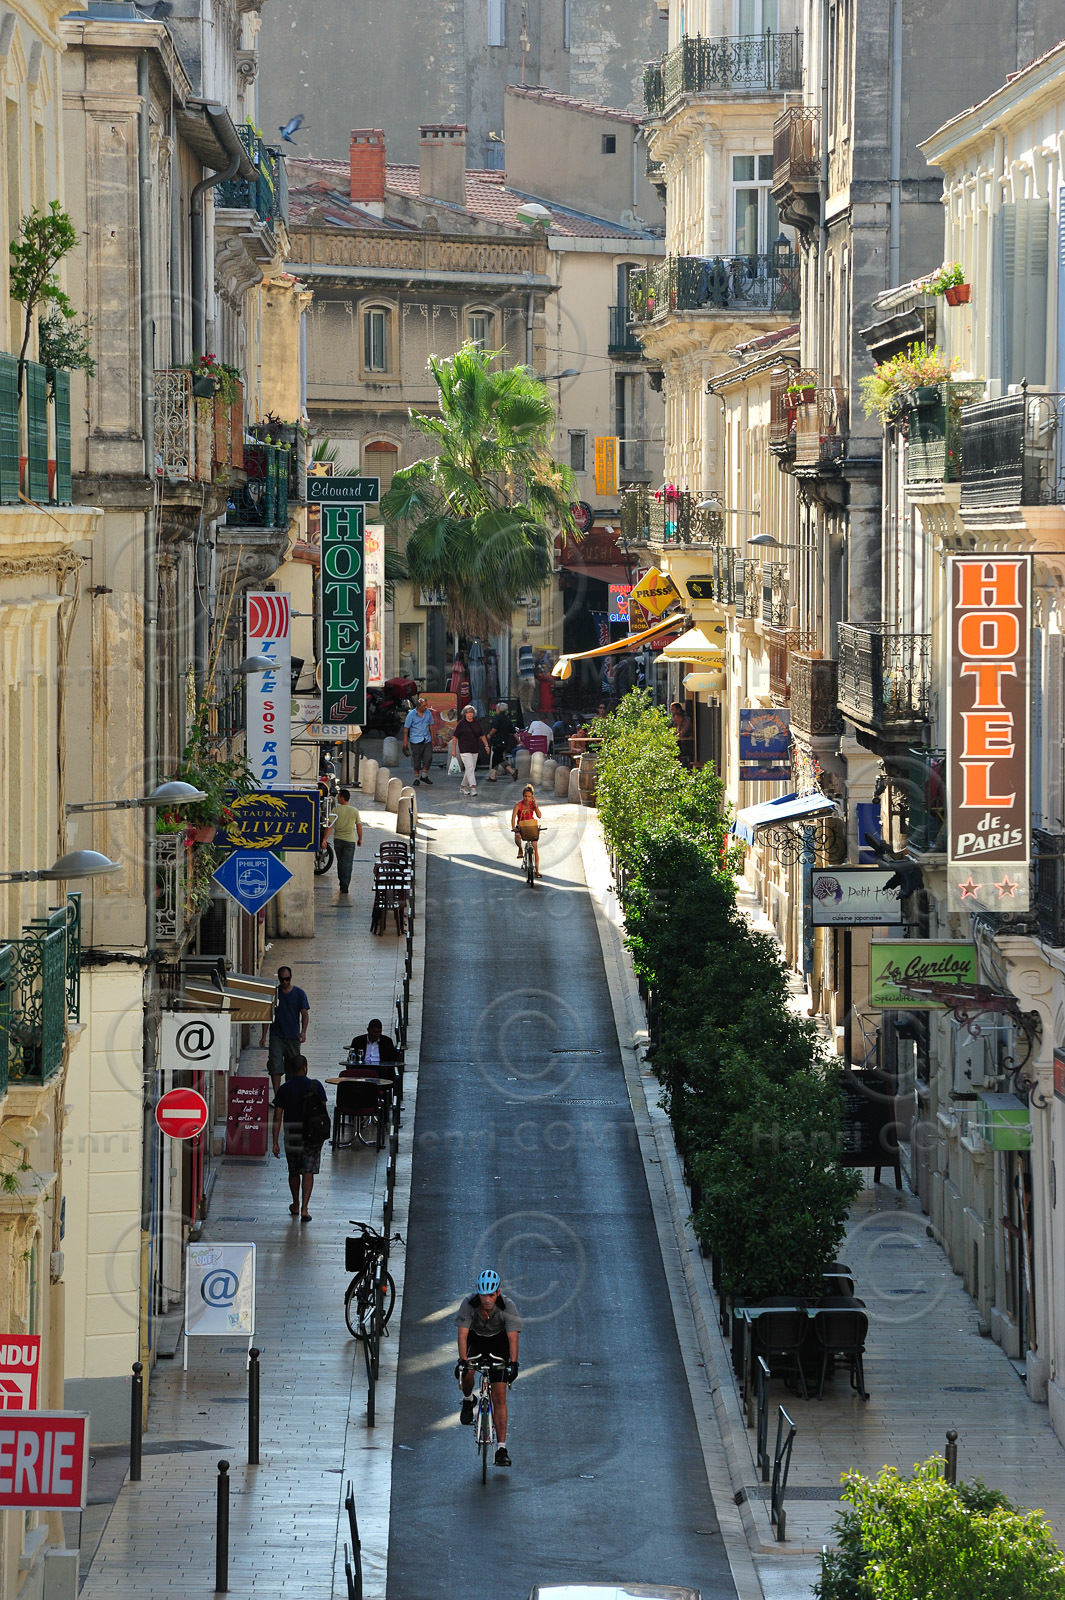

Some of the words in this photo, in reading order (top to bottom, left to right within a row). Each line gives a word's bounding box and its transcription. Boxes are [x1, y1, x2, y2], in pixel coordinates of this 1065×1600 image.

[311, 482, 361, 497] Edouard
[368, 484, 375, 497] 7
[324, 507, 362, 692] HOTEL
[955, 562, 1023, 808] HOTEL
[263, 701, 275, 734] SOS
[311, 725, 347, 735] MGSP
[239, 810, 297, 818] TAURANT
[241, 821, 309, 834] LIVIER
[904, 954, 971, 980] Cyrilou
[0, 1430, 75, 1494] ERIE
